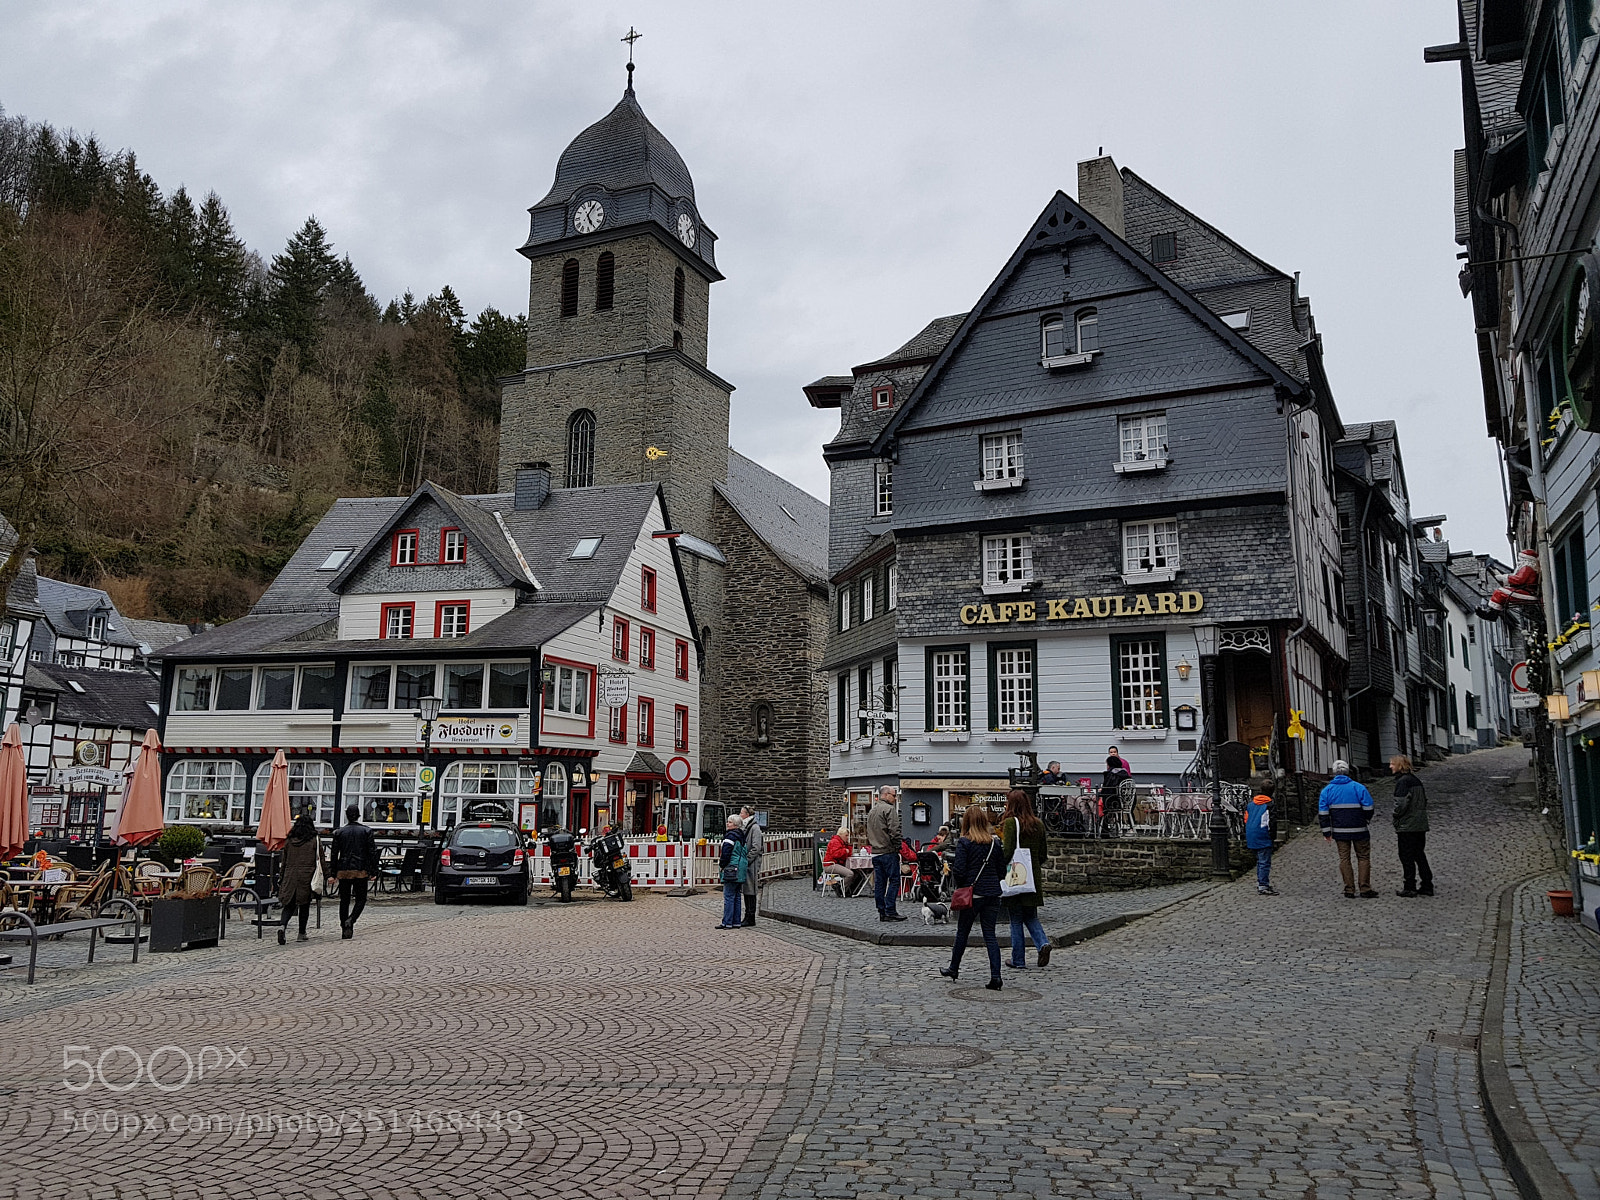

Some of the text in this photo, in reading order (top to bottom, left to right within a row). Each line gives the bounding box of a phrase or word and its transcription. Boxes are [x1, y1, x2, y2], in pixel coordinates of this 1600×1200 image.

[959, 591, 1204, 625] CAFE KAULARD
[438, 723, 496, 740] Flosdorff
[75, 768, 105, 776] Restaurant
[424, 771, 431, 780] H
[68, 774, 83, 782] Hotel
